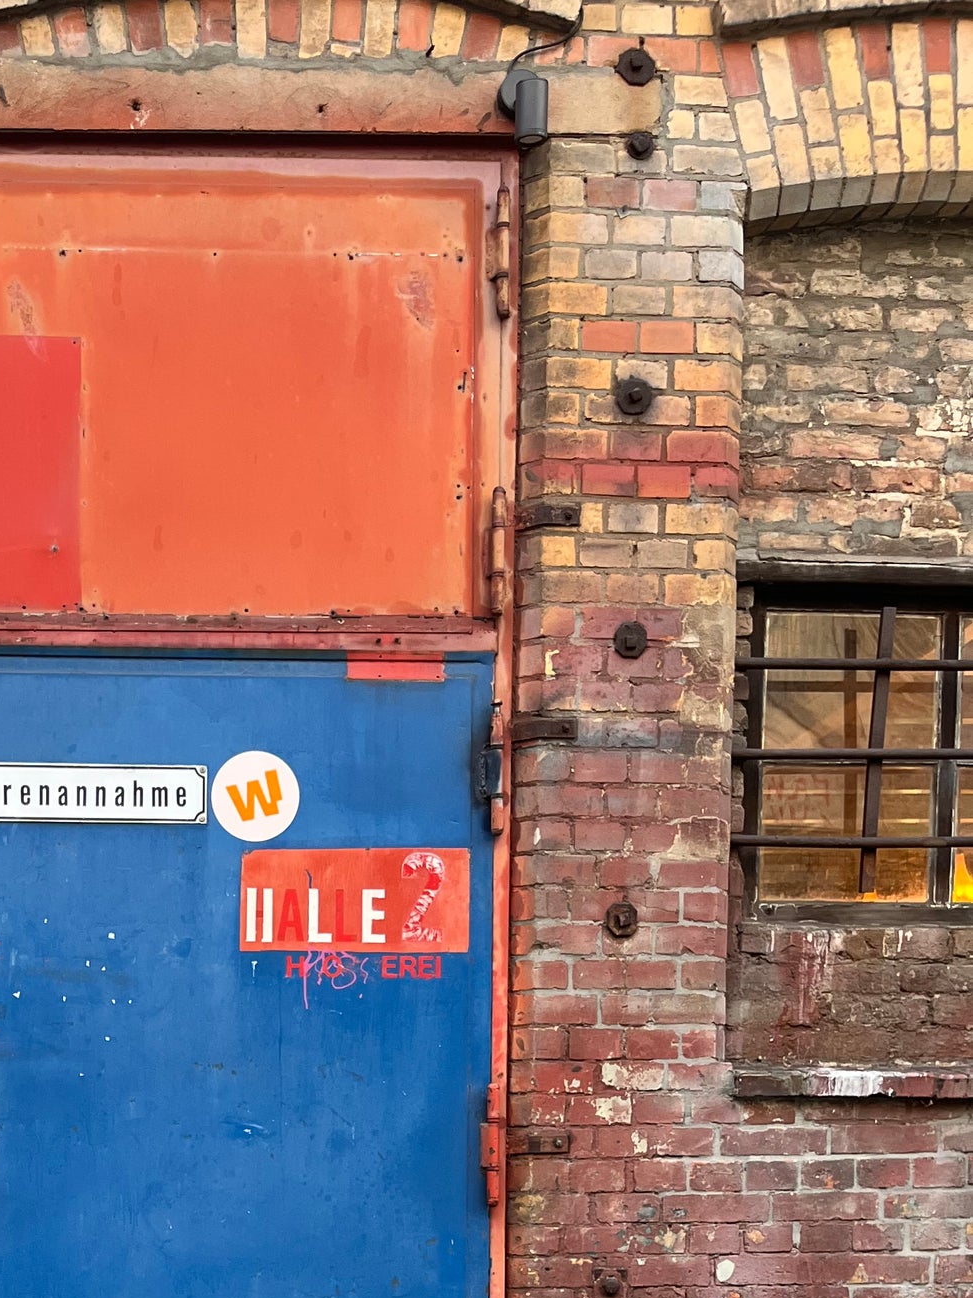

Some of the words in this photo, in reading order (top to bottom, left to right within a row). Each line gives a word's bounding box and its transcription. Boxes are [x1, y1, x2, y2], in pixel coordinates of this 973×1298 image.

[225, 769, 283, 822] W
[243, 886, 387, 944] HALLE
[400, 851, 445, 943] 2
